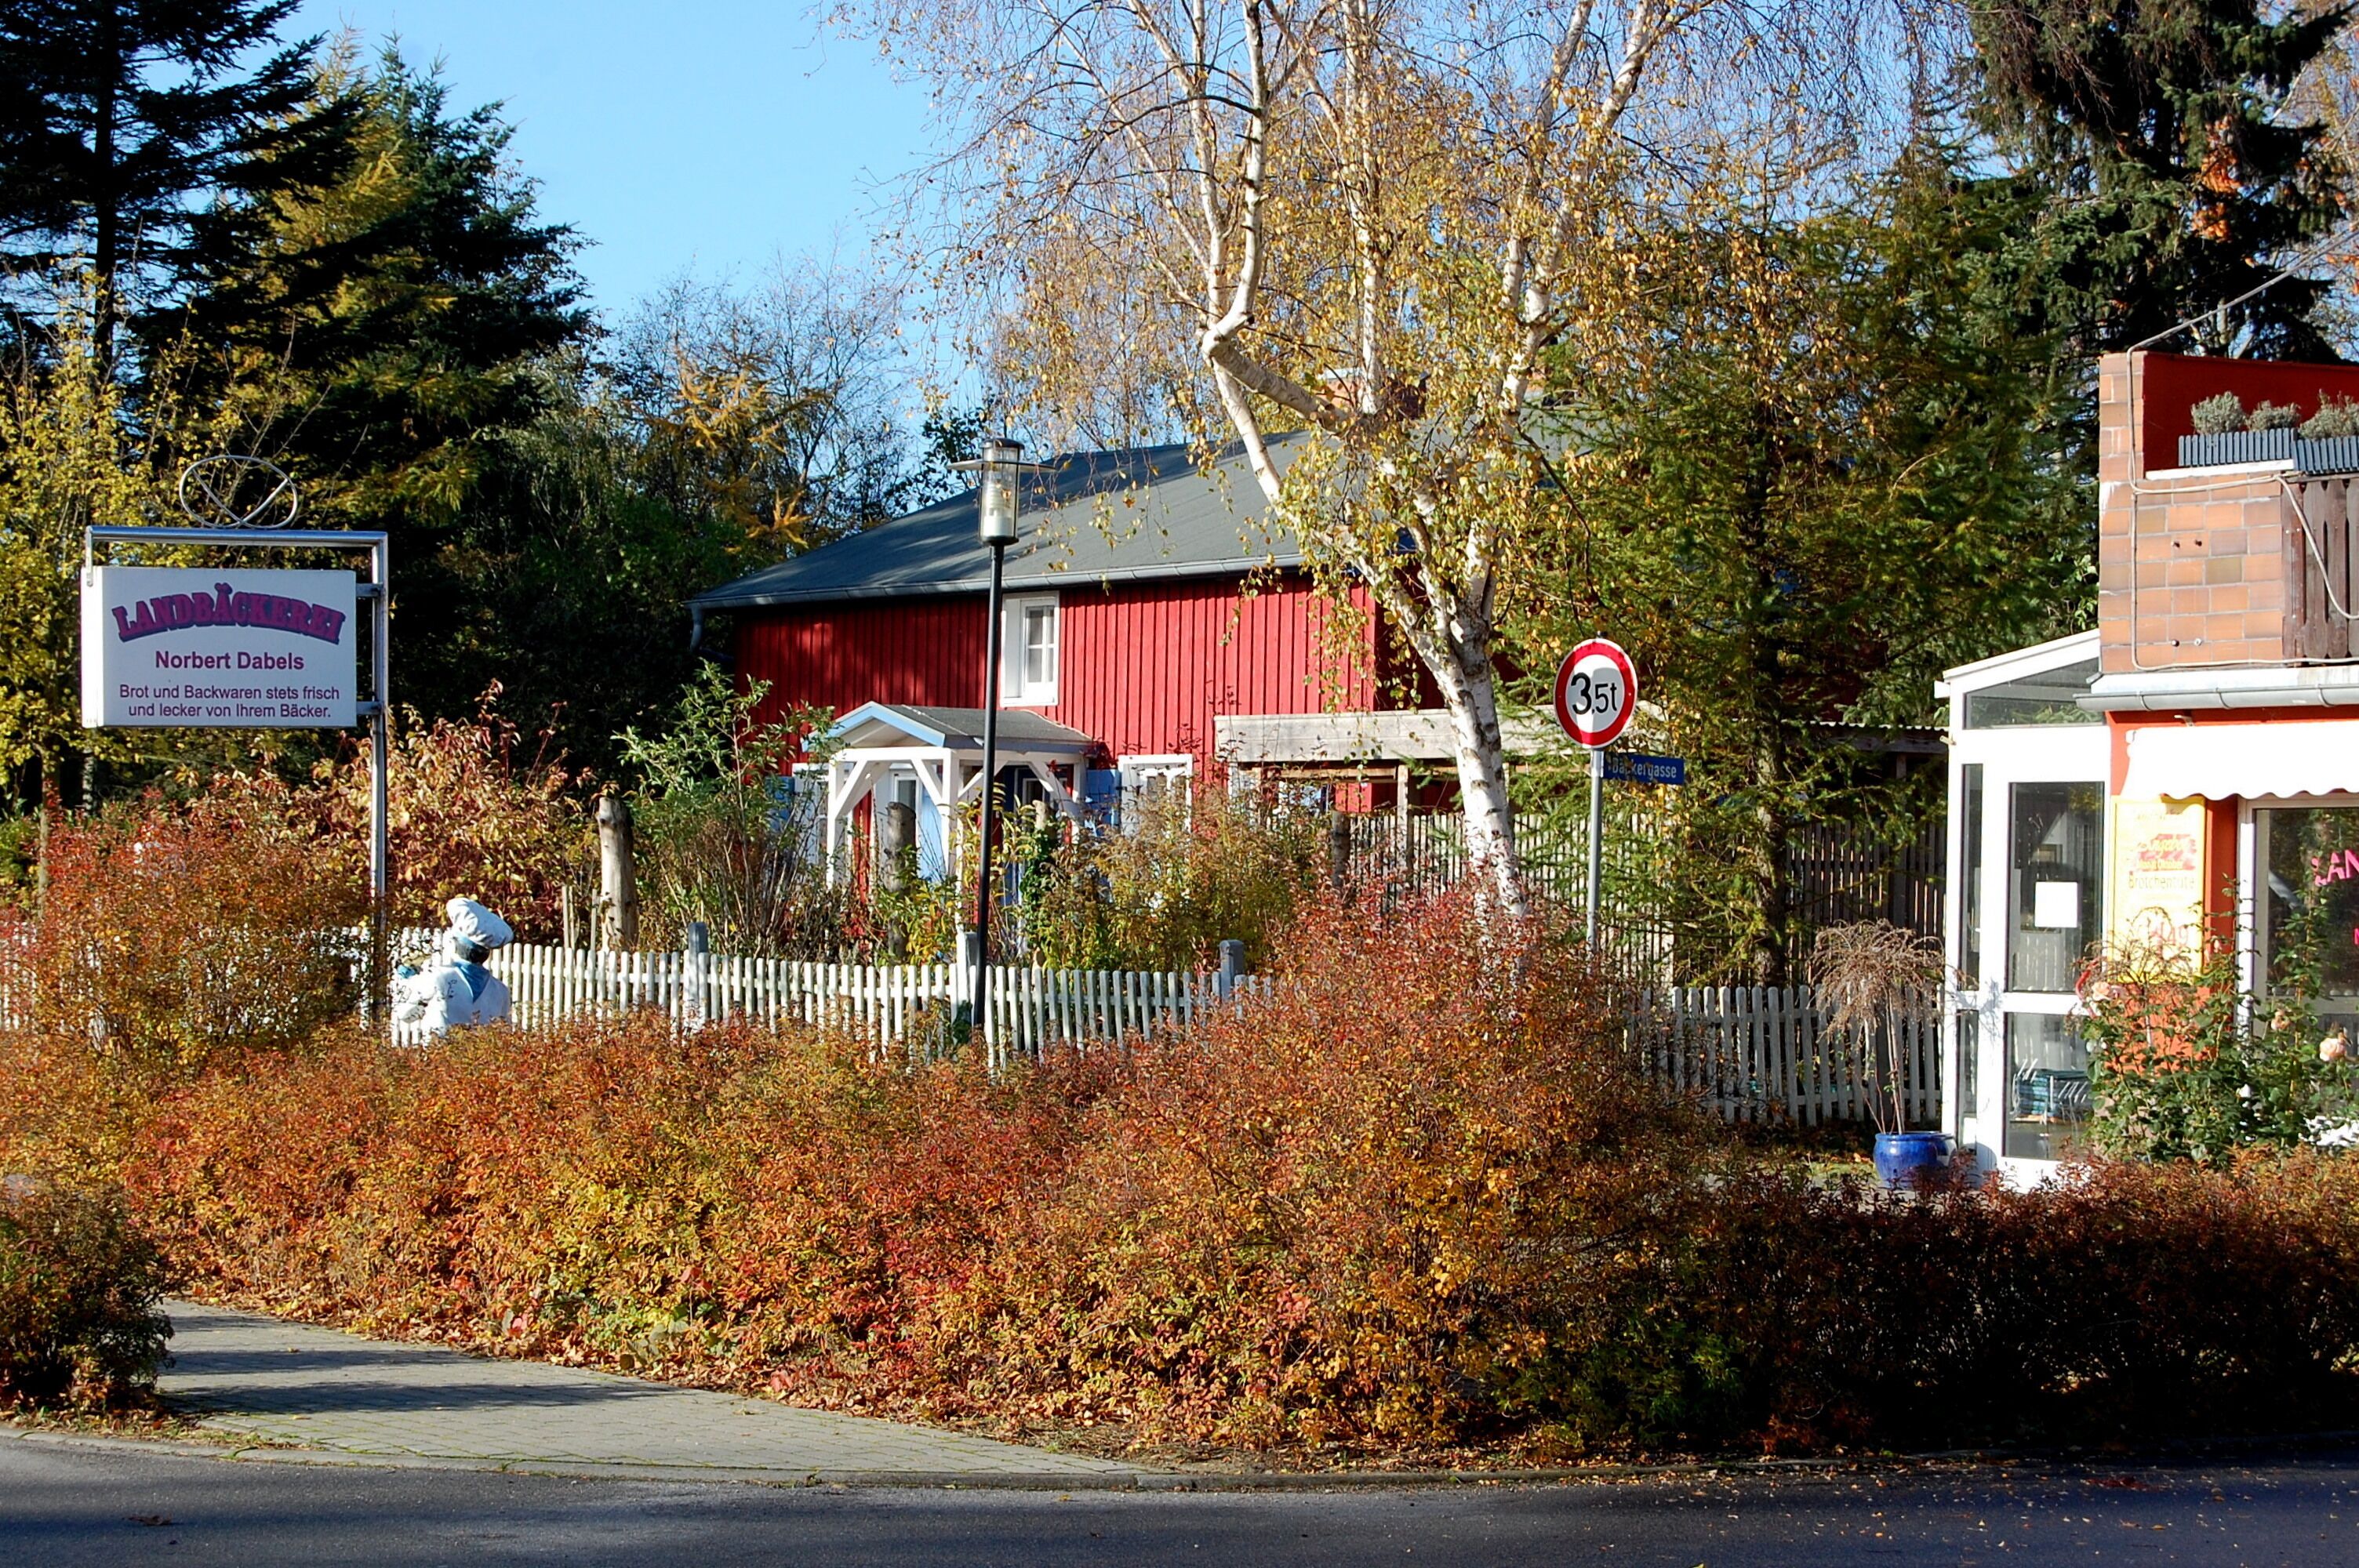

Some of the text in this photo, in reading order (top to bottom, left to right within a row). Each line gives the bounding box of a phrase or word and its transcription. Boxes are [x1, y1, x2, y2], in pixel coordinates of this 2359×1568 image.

[111, 582, 346, 644] LANDBÄCKEREI
[155, 651, 305, 670] Norbert Dabels
[119, 684, 340, 699] Brot und Backwaren stets frisch
[1570, 672, 1618, 715] 3,5t
[129, 703, 331, 718] und lecker von Ihrem Bäcker.
